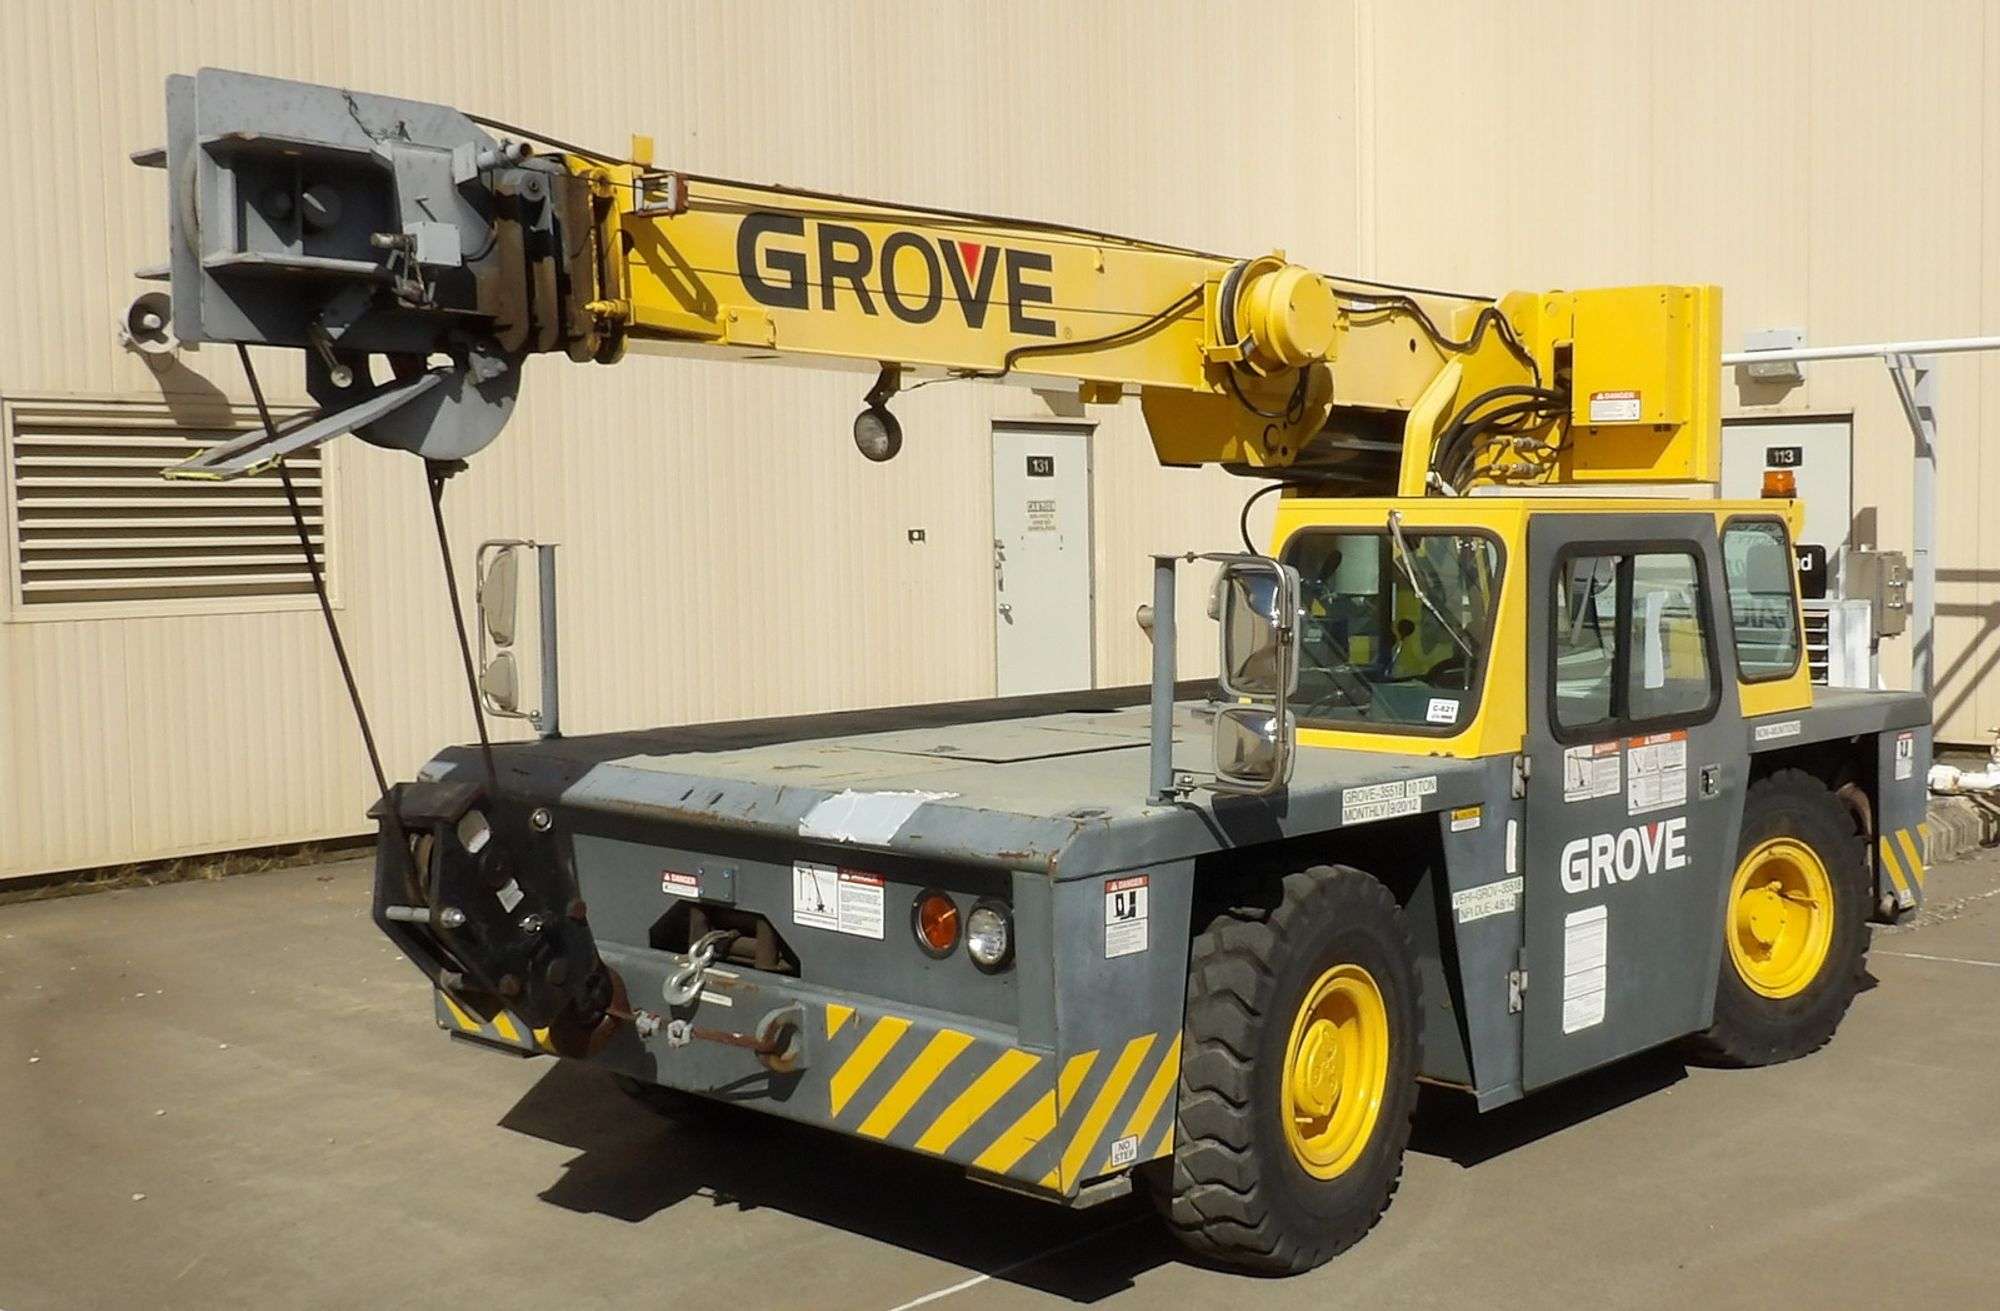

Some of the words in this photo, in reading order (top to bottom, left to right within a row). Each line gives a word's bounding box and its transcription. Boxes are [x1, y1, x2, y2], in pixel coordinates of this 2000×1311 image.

[737, 212, 1057, 338] GROVE
[1774, 449, 1794, 464] 113
[1032, 459, 1049, 473] 131
[1344, 801, 1387, 821] MONTHLY
[1560, 817, 1687, 894] GROVE
[1118, 1141, 1131, 1151] NO
[1114, 1149, 1135, 1163] STEP
